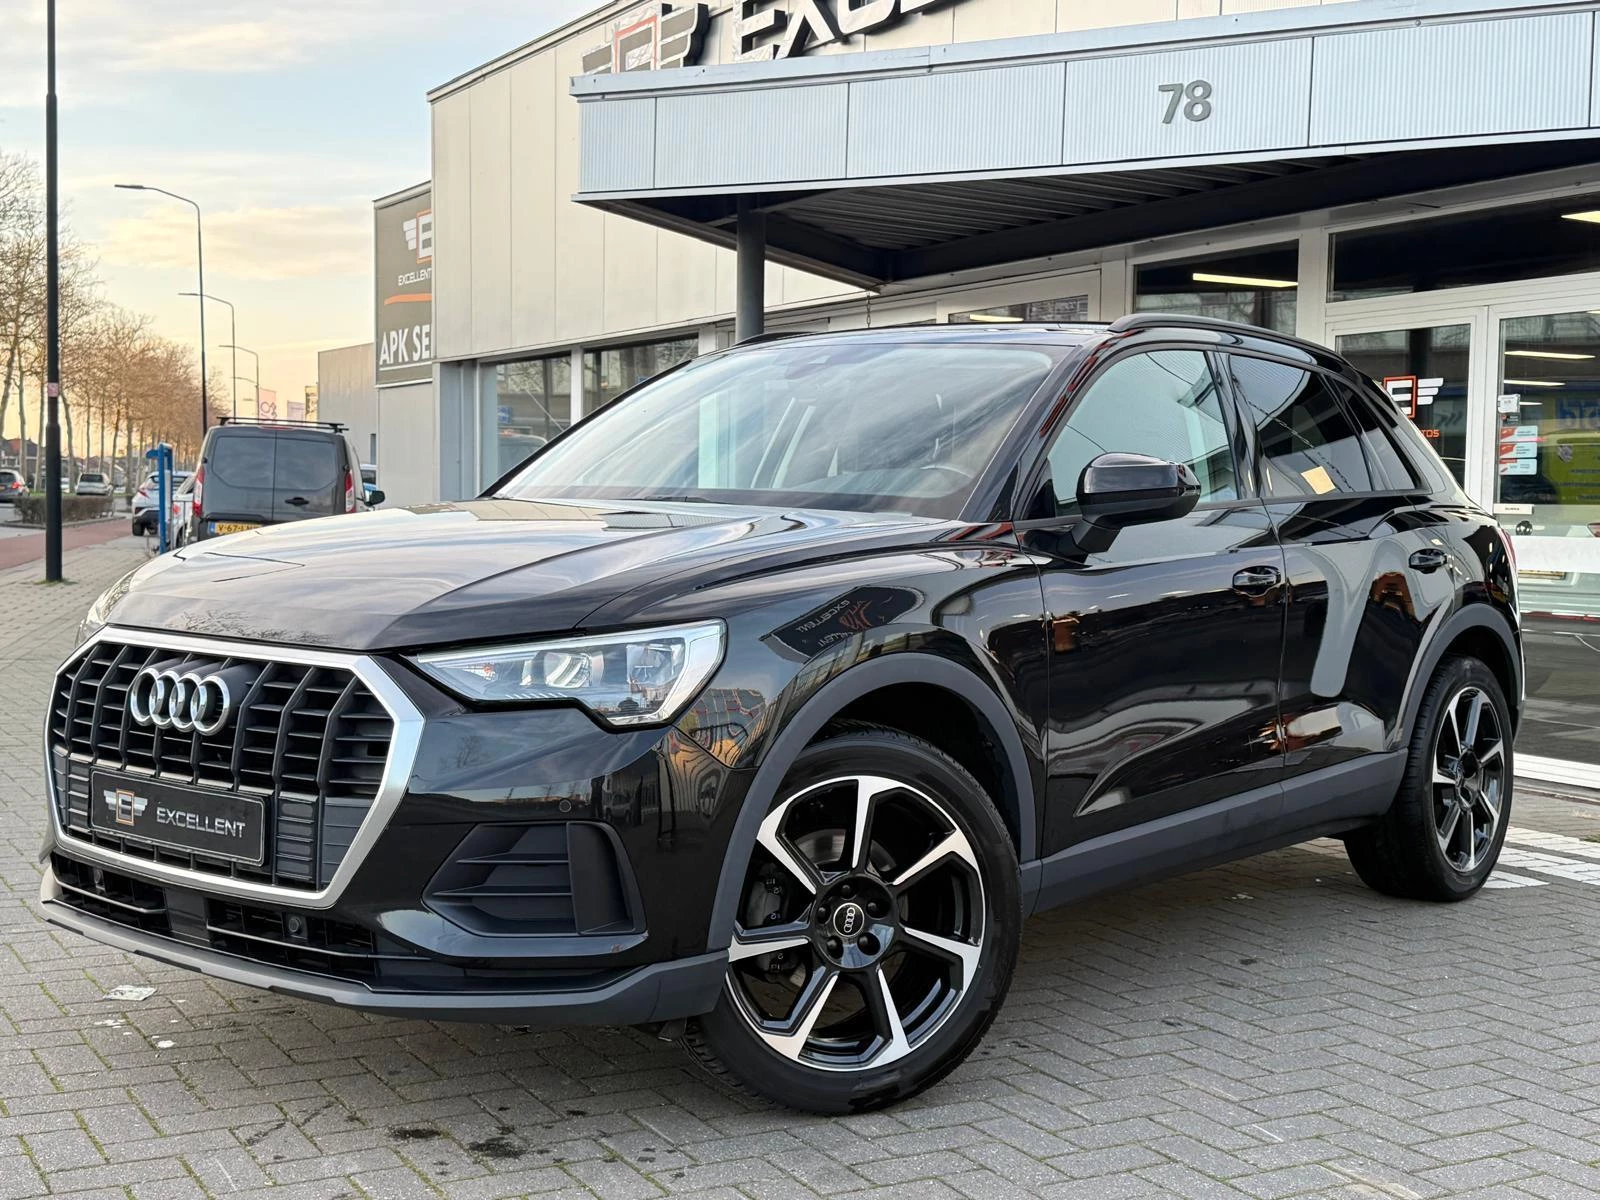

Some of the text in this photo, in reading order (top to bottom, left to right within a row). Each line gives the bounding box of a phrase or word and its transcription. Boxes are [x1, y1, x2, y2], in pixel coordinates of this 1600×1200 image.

[1158, 79, 1212, 125] 78
[379, 328, 409, 365] APK
[1421, 429, 1440, 438] TOS
[156, 806, 246, 838] EXCELLENT
